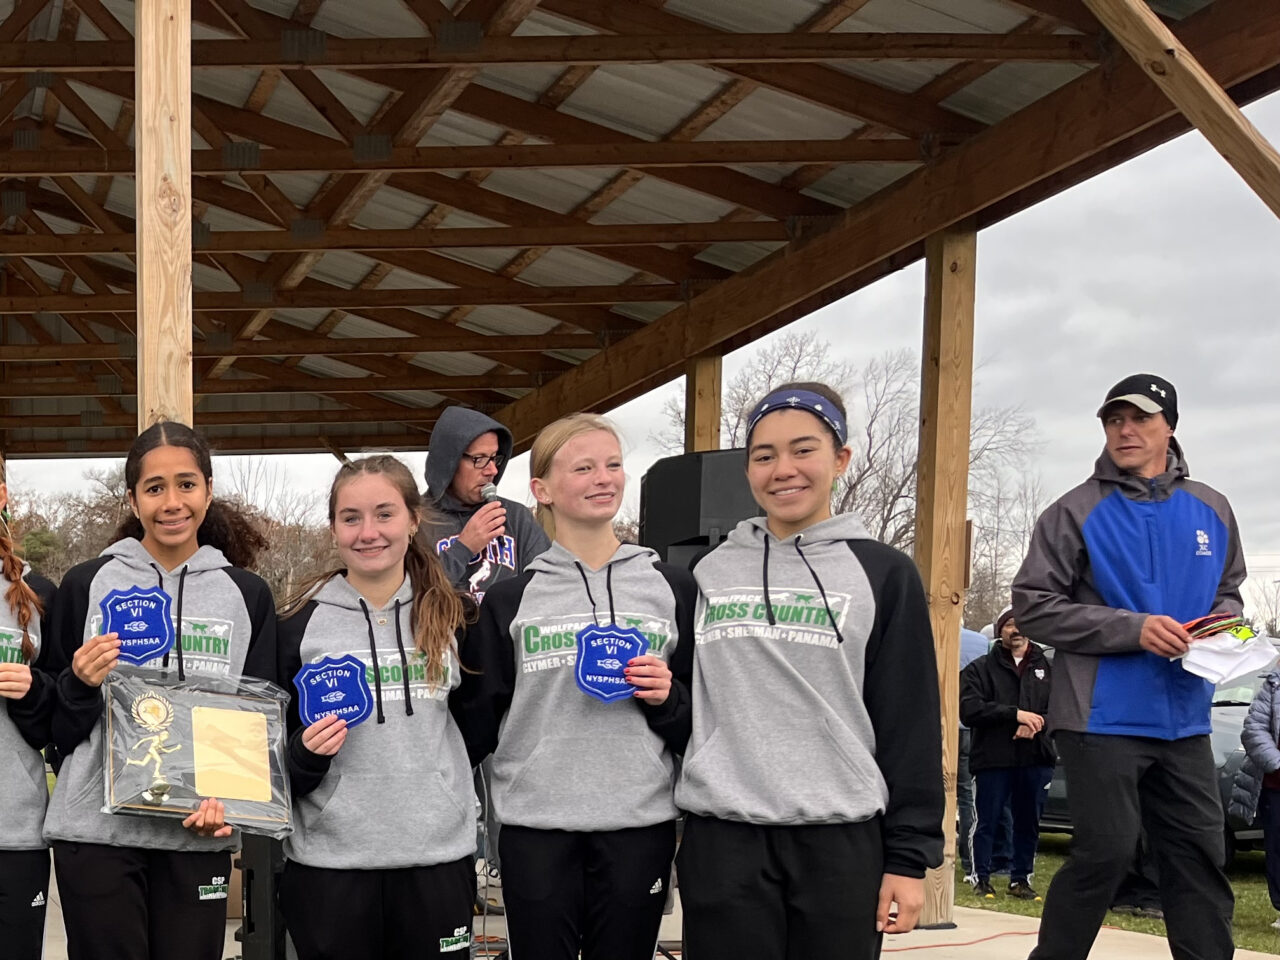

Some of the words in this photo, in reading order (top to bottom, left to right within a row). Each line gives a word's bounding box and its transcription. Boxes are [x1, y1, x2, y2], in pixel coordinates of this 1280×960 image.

[115, 600, 156, 611] SECTION
[130, 608, 142, 616] VI
[704, 603, 749, 626] ROSS
[120, 637, 160, 646] YSPHSAA
[173, 634, 230, 656] UNTRY
[524, 625, 578, 654] CROS
[590, 637, 632, 650] SECTION
[787, 631, 839, 649] PANAMA
[605, 646, 617, 655] VI
[310, 669, 351, 685] SECTION
[325, 678, 337, 688] VI
[586, 675, 628, 684] NYSPHSA
